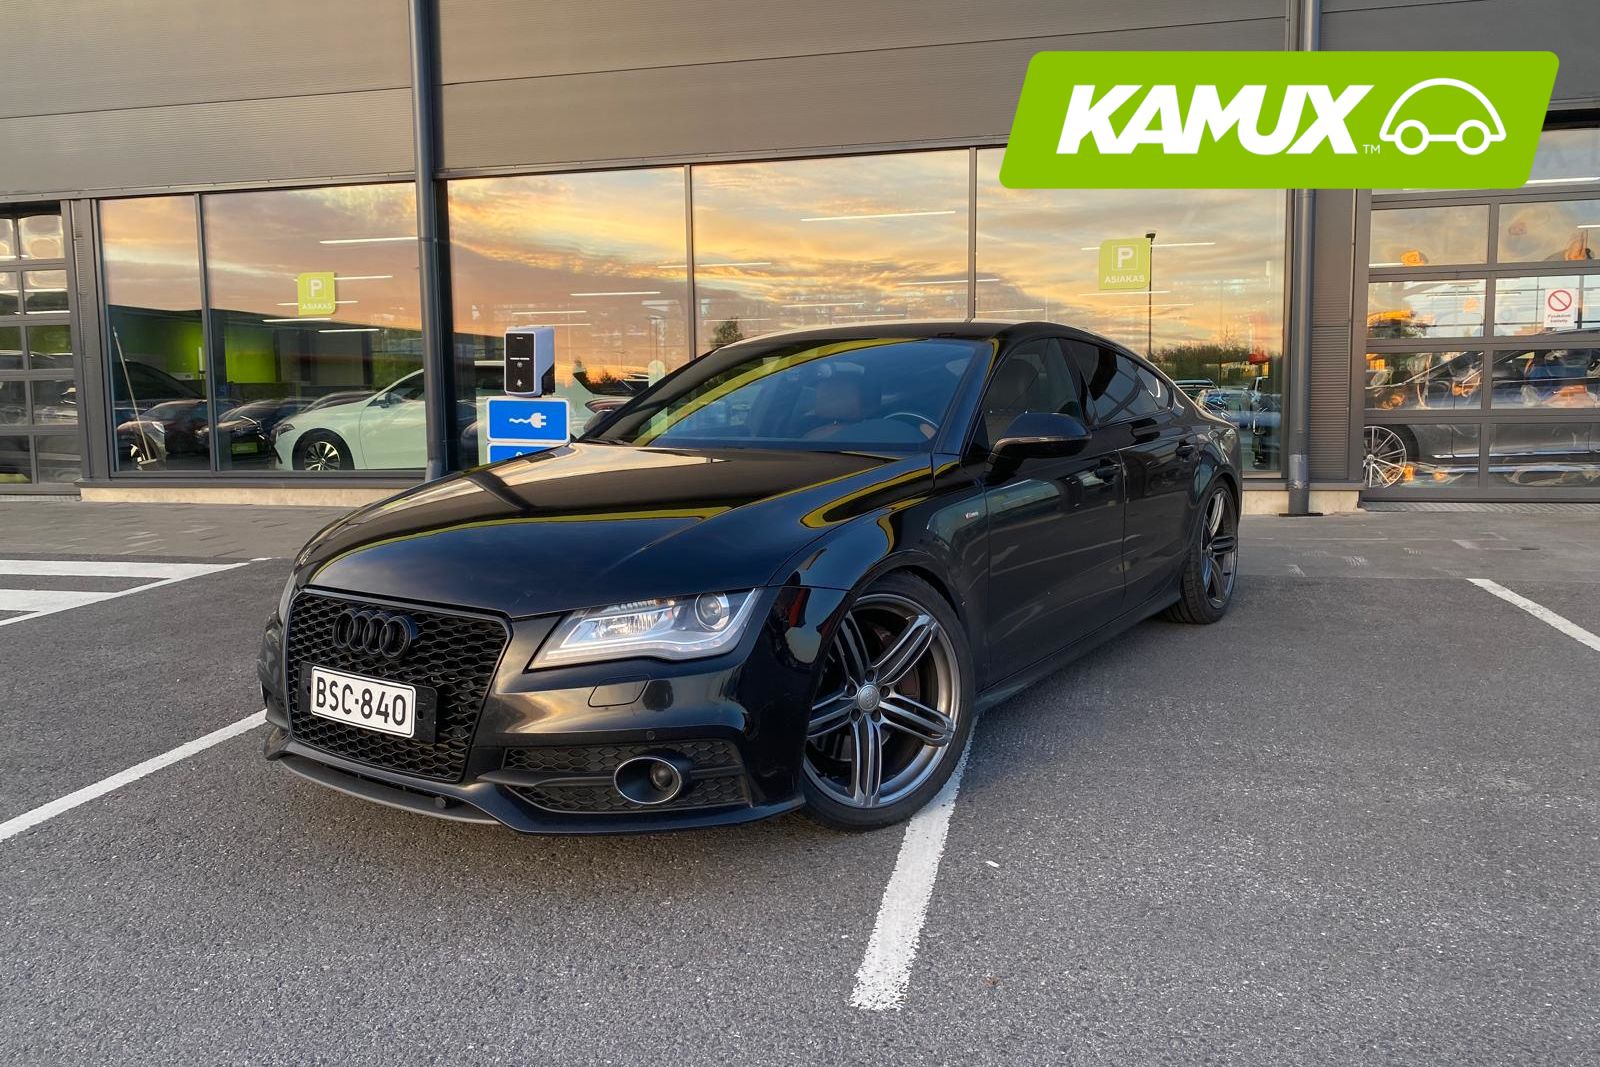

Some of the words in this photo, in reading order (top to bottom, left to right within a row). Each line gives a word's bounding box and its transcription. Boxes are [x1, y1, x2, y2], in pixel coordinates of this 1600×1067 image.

[1117, 247, 1133, 268] P
[311, 279, 322, 297] P
[1104, 274, 1145, 284] ASIAKAS
[316, 676, 406, 726] BSC-840
